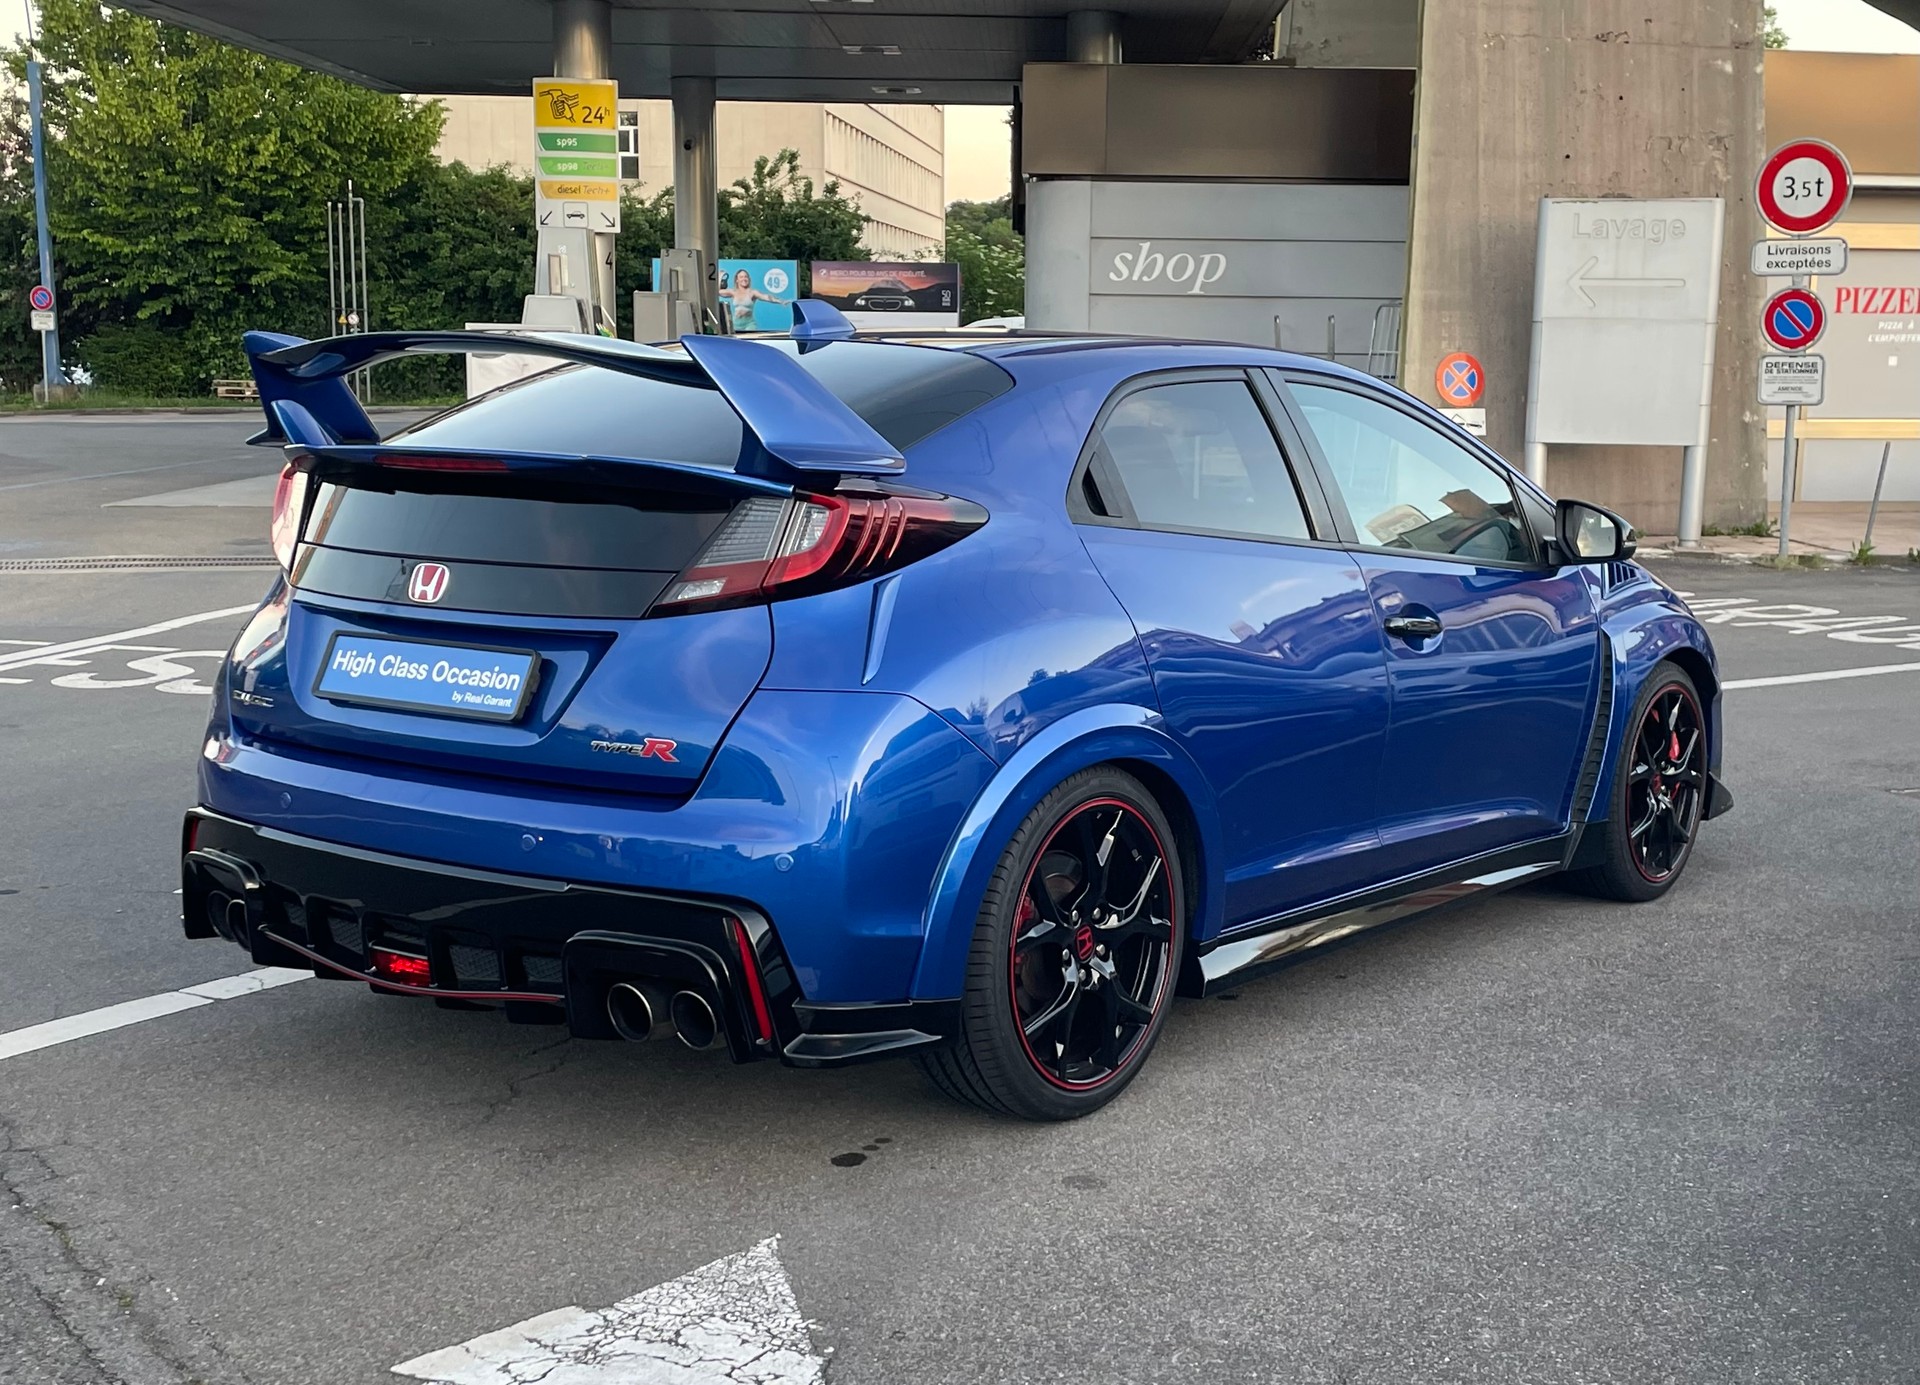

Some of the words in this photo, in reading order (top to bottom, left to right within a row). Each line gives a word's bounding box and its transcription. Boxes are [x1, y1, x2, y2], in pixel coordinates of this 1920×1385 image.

[556, 138, 578, 148] sp95
[557, 163, 578, 173] sp98
[557, 185, 581, 194] diesel
[583, 185, 610, 194] Tech+
[1573, 212, 1686, 245] Lavage
[1767, 244, 1832, 256] Livraisons
[605, 252, 613, 270] 4
[1108, 241, 1227, 294] shop
[1766, 257, 1832, 271] exceptées
[708, 263, 717, 281] 2
[767, 277, 780, 289] 49
[1834, 287, 1920, 314] PIZZE
[1878, 321, 1903, 330] PIZZA
[332, 650, 376, 678] High
[378, 655, 429, 681] Class
[431, 660, 520, 691] Occasion
[452, 691, 463, 703] by
[463, 693, 484, 704] Real
[483, 695, 512, 707] Garant
[590, 740, 643, 755] TYPE
[640, 737, 680, 763] R
